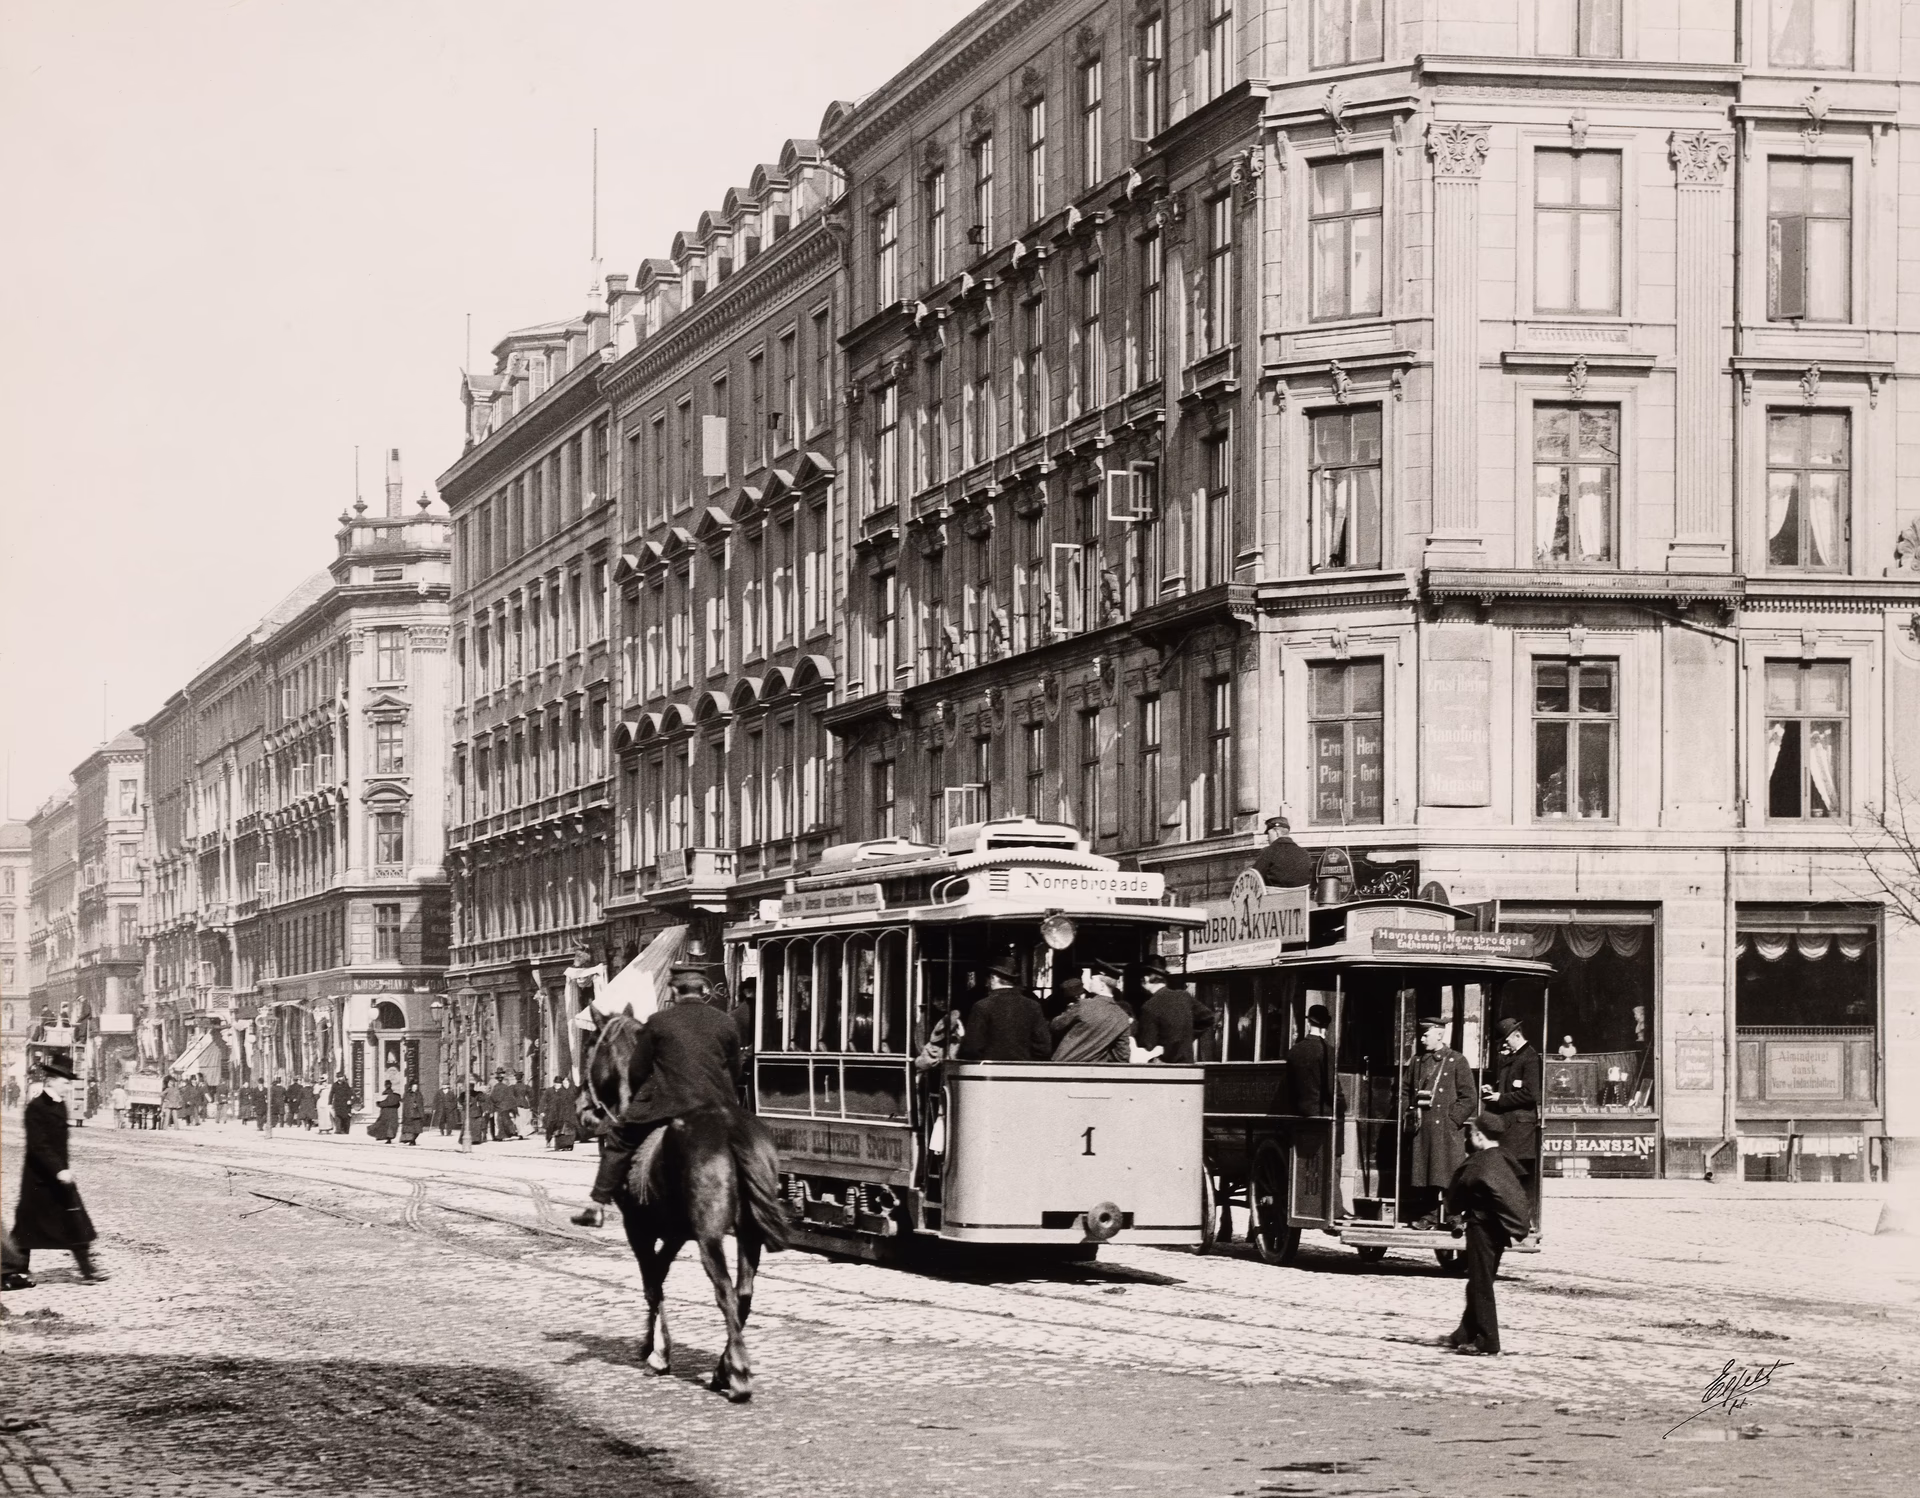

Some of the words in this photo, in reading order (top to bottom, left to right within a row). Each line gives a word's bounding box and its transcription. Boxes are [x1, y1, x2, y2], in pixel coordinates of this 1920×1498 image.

[1425, 724, 1488, 743] Pianoforte
[1779, 1050, 1829, 1064] Almindeligt
[1791, 1064, 1817, 1075] dansk
[1080, 1126, 1096, 1156] 1
[1542, 1139, 1573, 1152] NUS
